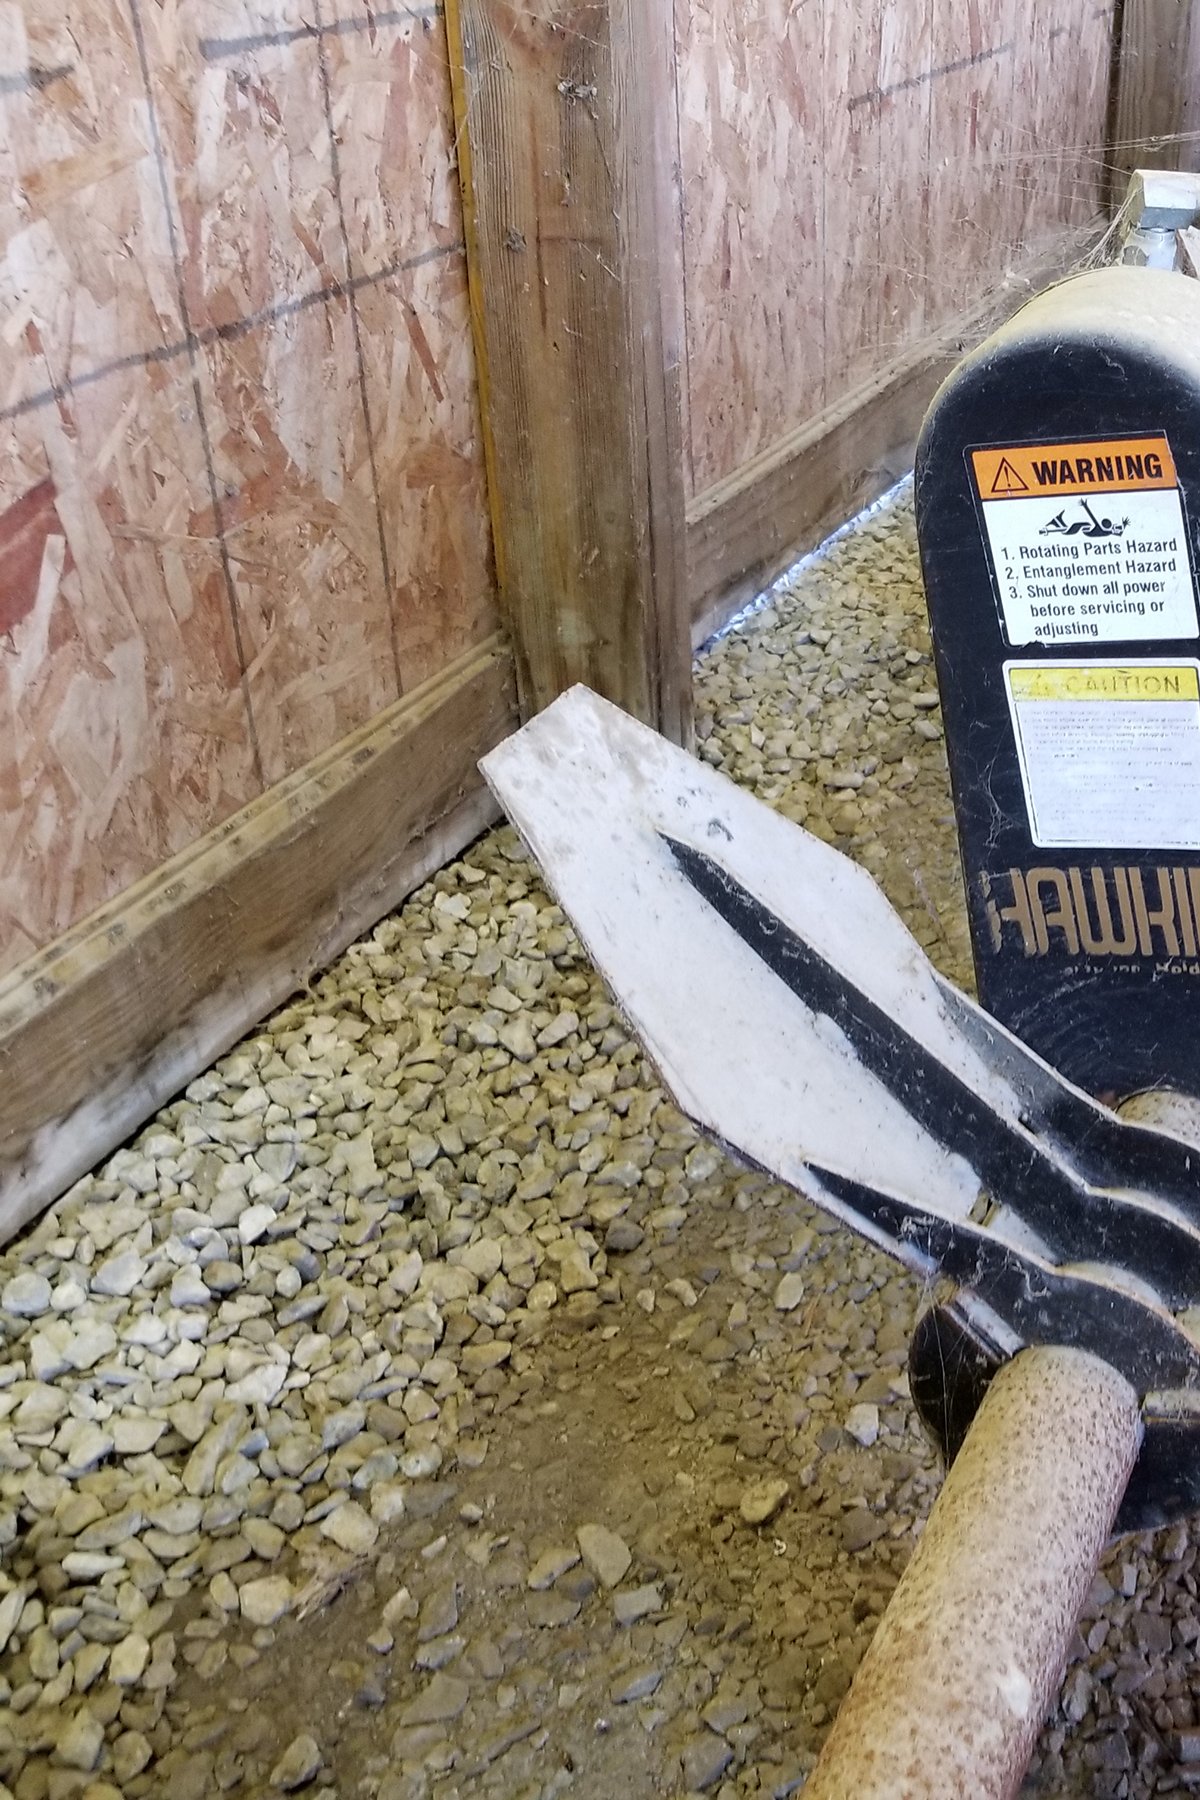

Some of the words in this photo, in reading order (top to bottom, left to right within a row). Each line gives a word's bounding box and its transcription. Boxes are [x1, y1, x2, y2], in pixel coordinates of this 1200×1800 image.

[1031, 453, 1163, 486] WARNING
[1001, 547, 1015, 561] 1.
[1019, 544, 1079, 560] Rotating
[1084, 541, 1121, 556] Parts
[1126, 538, 1177, 553] Hazard
[1005, 566, 1018, 580] 2.
[1023, 562, 1121, 580] Entanglement
[1126, 558, 1176, 574] Hazard
[1009, 585, 1022, 599] 3.
[1027, 584, 1057, 599] Shut
[1062, 582, 1098, 597] down
[1103, 580, 1119, 595] all
[1123, 580, 1166, 596] power
[1030, 602, 1075, 618] before
[1080, 599, 1145, 616] servicing
[1150, 600, 1165, 613] or
[1034, 621, 1098, 638] adjusting
[1065, 674, 1180, 694] CAUTION
